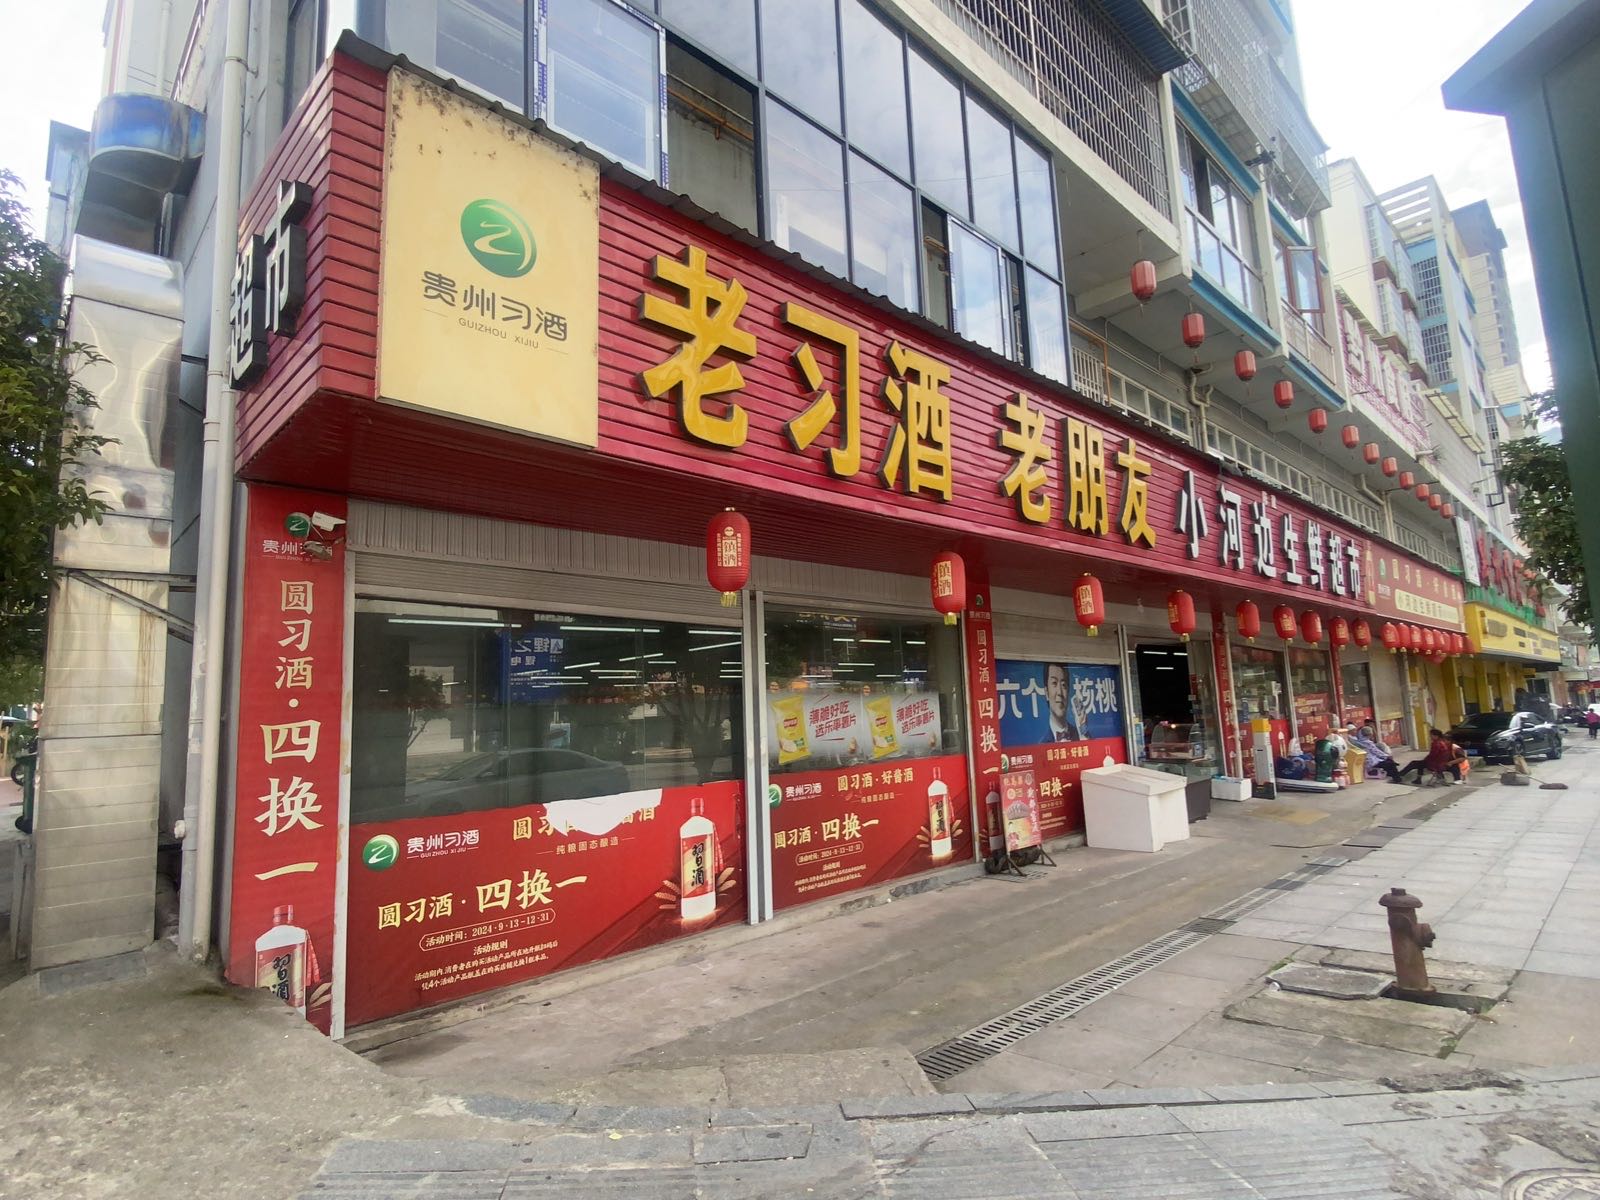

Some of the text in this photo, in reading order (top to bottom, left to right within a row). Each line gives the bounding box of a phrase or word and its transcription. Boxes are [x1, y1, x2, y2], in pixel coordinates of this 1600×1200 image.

[230, 179, 308, 388] 超市
[420, 270, 569, 342] 贵州习酒
[458, 317, 539, 349] GUIZHOU XIJIU
[637, 243, 1157, 548] 老习酒 老朋友
[262, 539, 333, 556] 贵州
[1176, 470, 1360, 599] 小河边生鲜超市
[995, 677, 1118, 720] 六个 核桃
[785, 782, 822, 798] 贵州习酒
[407, 829, 480, 854] 贵州习酒
[556, 836, 619, 855] 纯粮固态酿造
[774, 812, 880, 849] 圆习酒·四换一
[378, 868, 588, 930] 圆习酒·四换一
[473, 939, 508, 956] 活动规则
